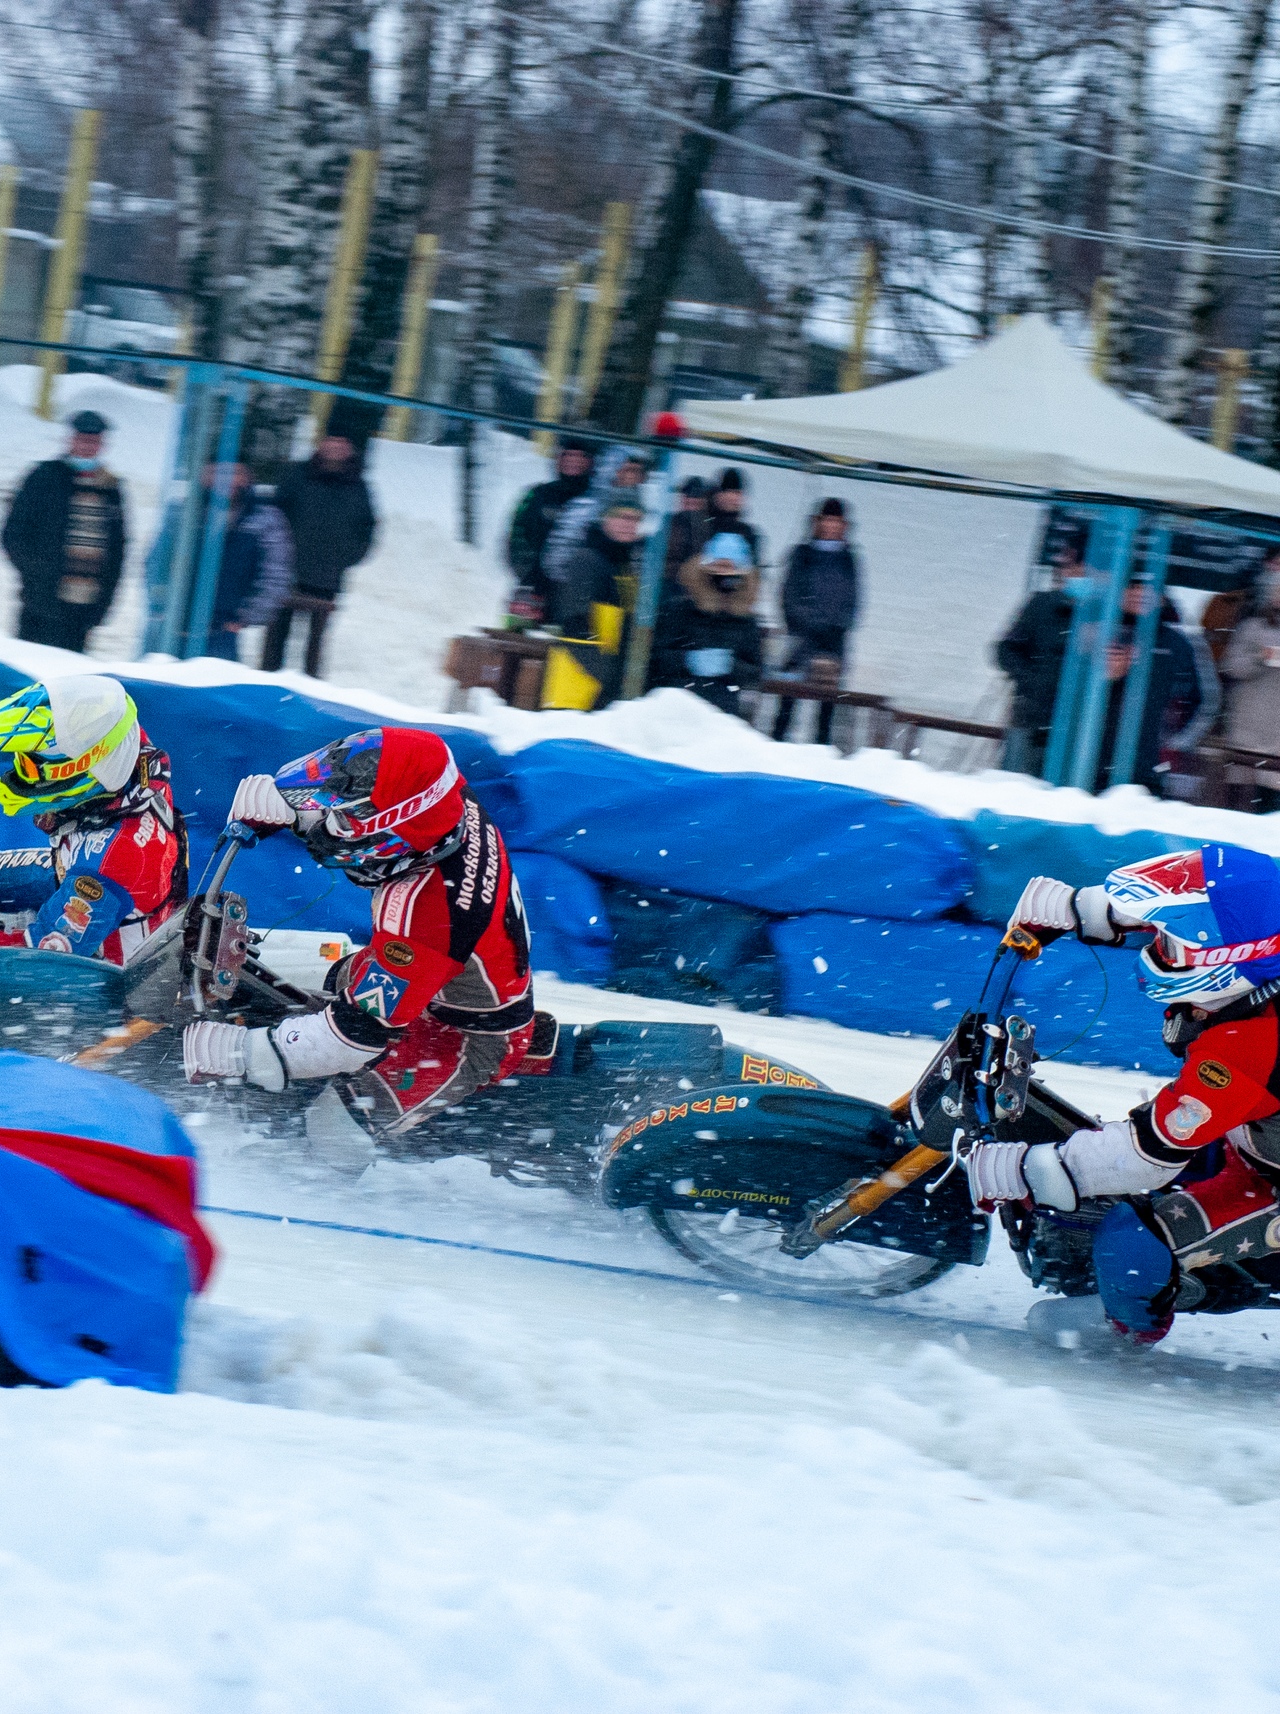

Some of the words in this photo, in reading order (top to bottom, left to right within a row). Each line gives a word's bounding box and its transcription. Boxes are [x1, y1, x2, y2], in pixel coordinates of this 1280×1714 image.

[49, 740, 109, 780] 100%
[387, 882, 408, 924] Castrol
[1190, 935, 1278, 966] 100%
[699, 1187, 790, 1206] ДОСТАВКИН
